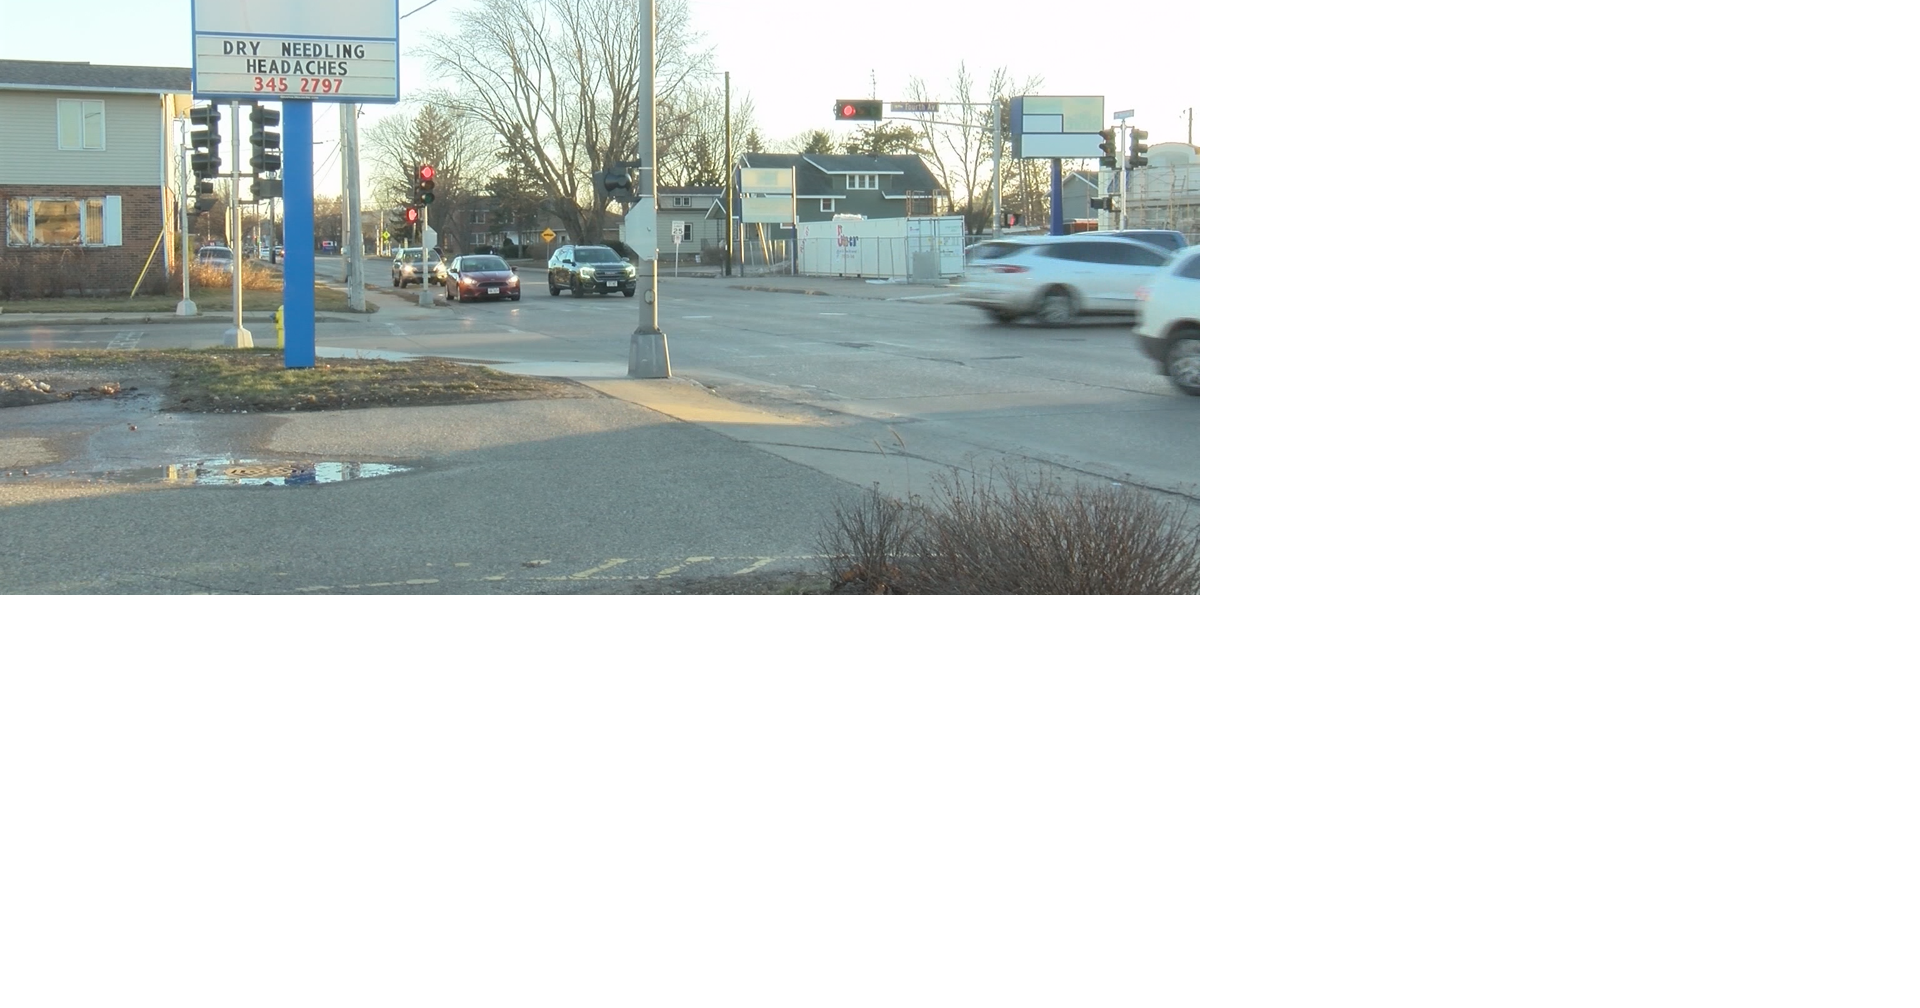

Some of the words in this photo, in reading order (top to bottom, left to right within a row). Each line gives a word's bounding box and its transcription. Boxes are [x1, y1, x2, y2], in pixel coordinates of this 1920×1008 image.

[223, 40, 261, 56] DRY
[281, 42, 365, 59] NEEDLING
[246, 58, 348, 76] HEADACHES
[254, 76, 288, 92] 345
[300, 78, 343, 93] 2797
[905, 102, 925, 111] Fourth
